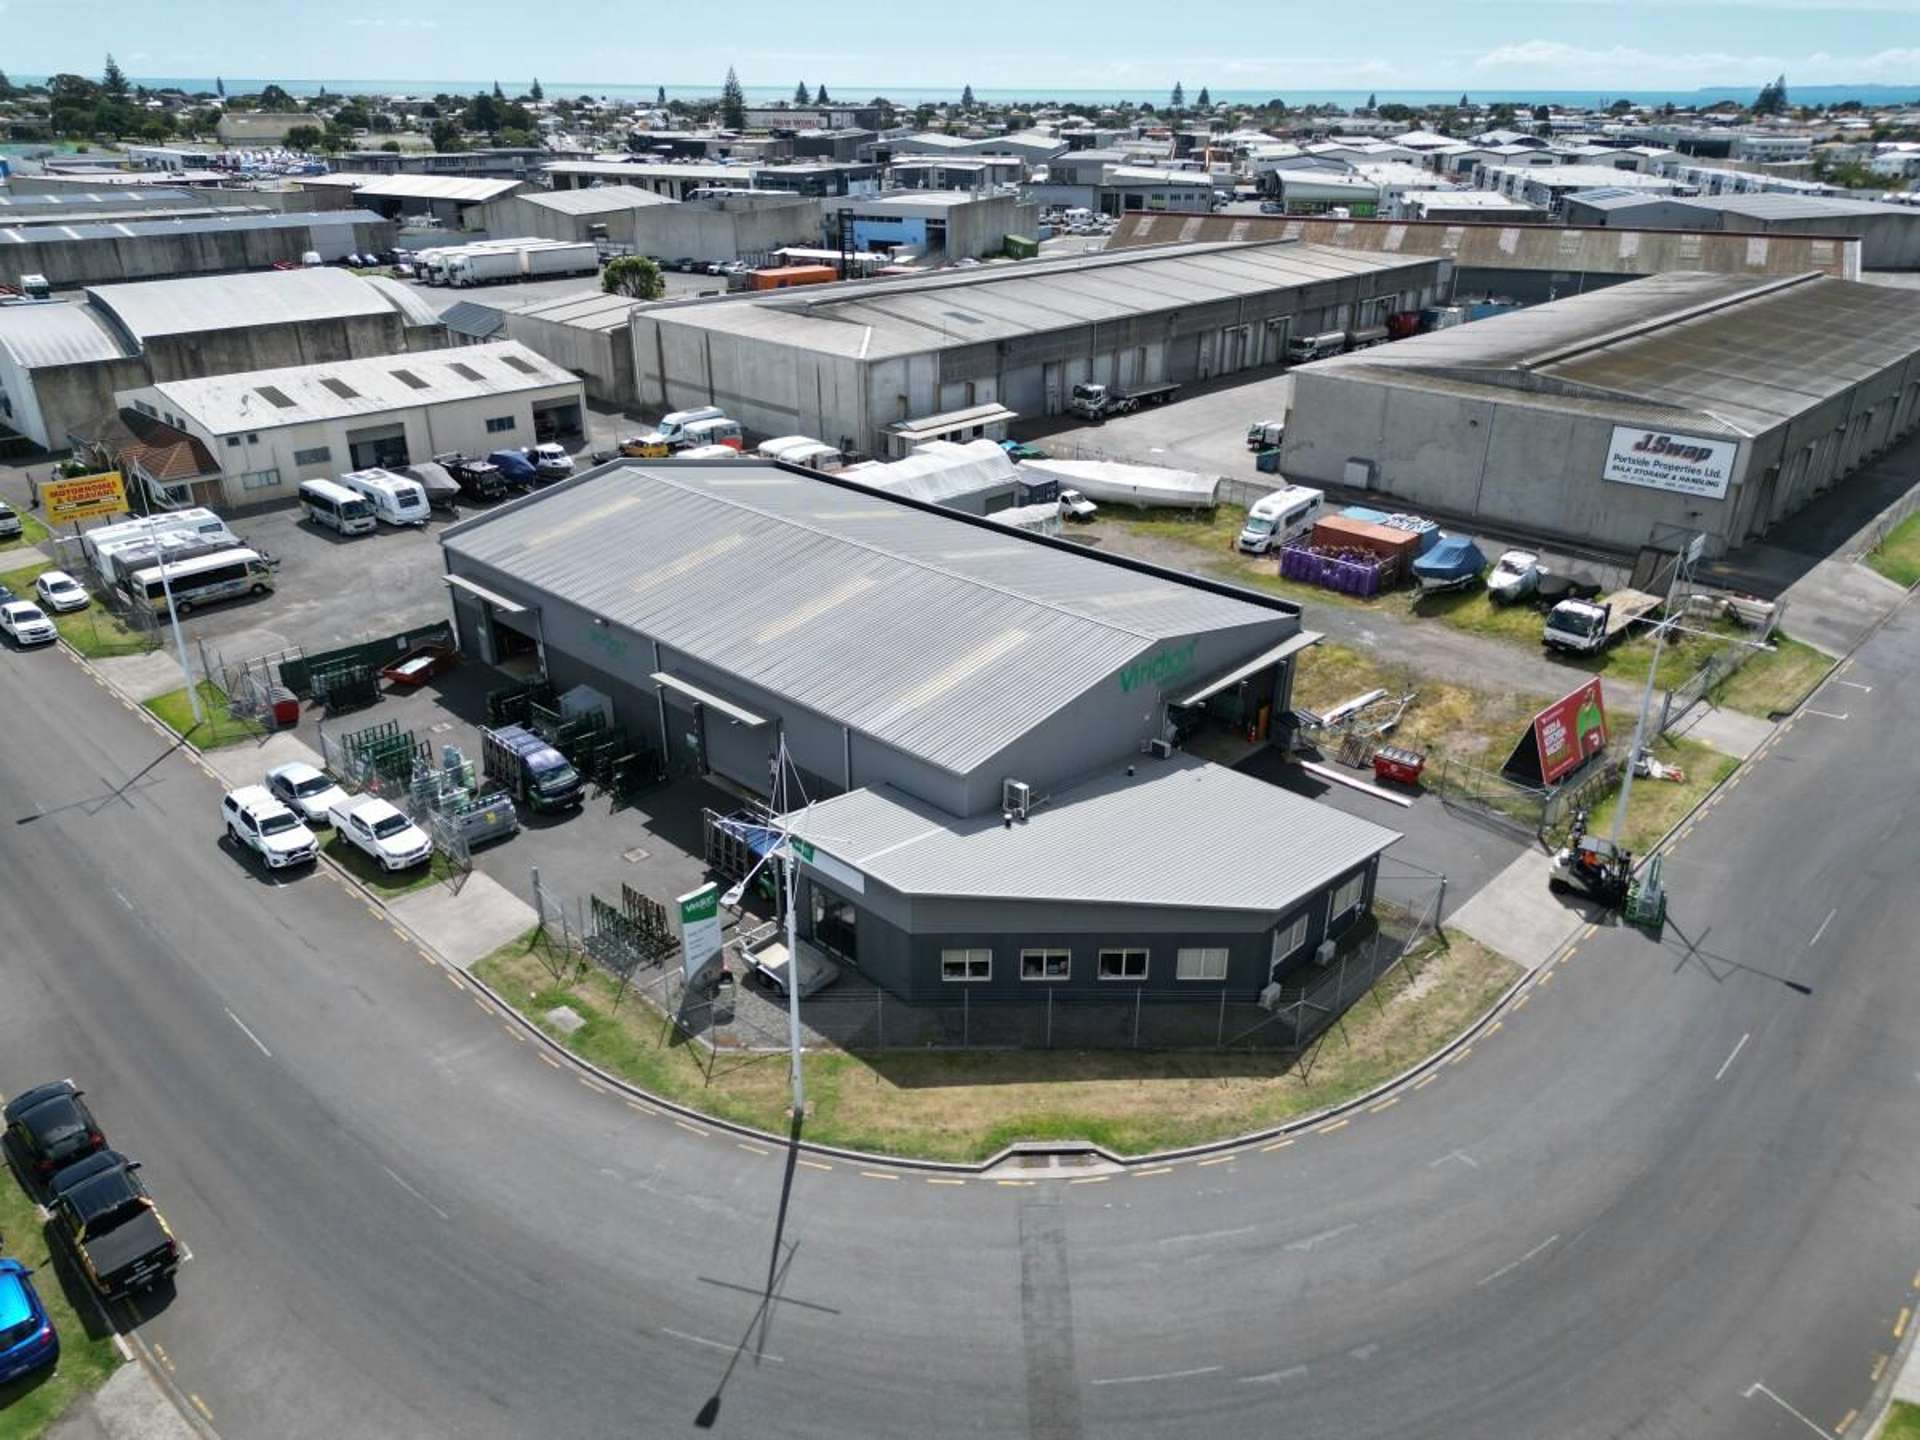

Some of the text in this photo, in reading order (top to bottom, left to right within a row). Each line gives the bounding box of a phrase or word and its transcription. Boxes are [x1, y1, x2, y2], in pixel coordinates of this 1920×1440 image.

[1633, 434, 1713, 462] J.Swap
[1613, 453, 1650, 467] Portside
[1653, 459, 1702, 475] Properties
[1634, 468, 1670, 481] STORAGE
[1679, 475, 1720, 488] HANDLING
